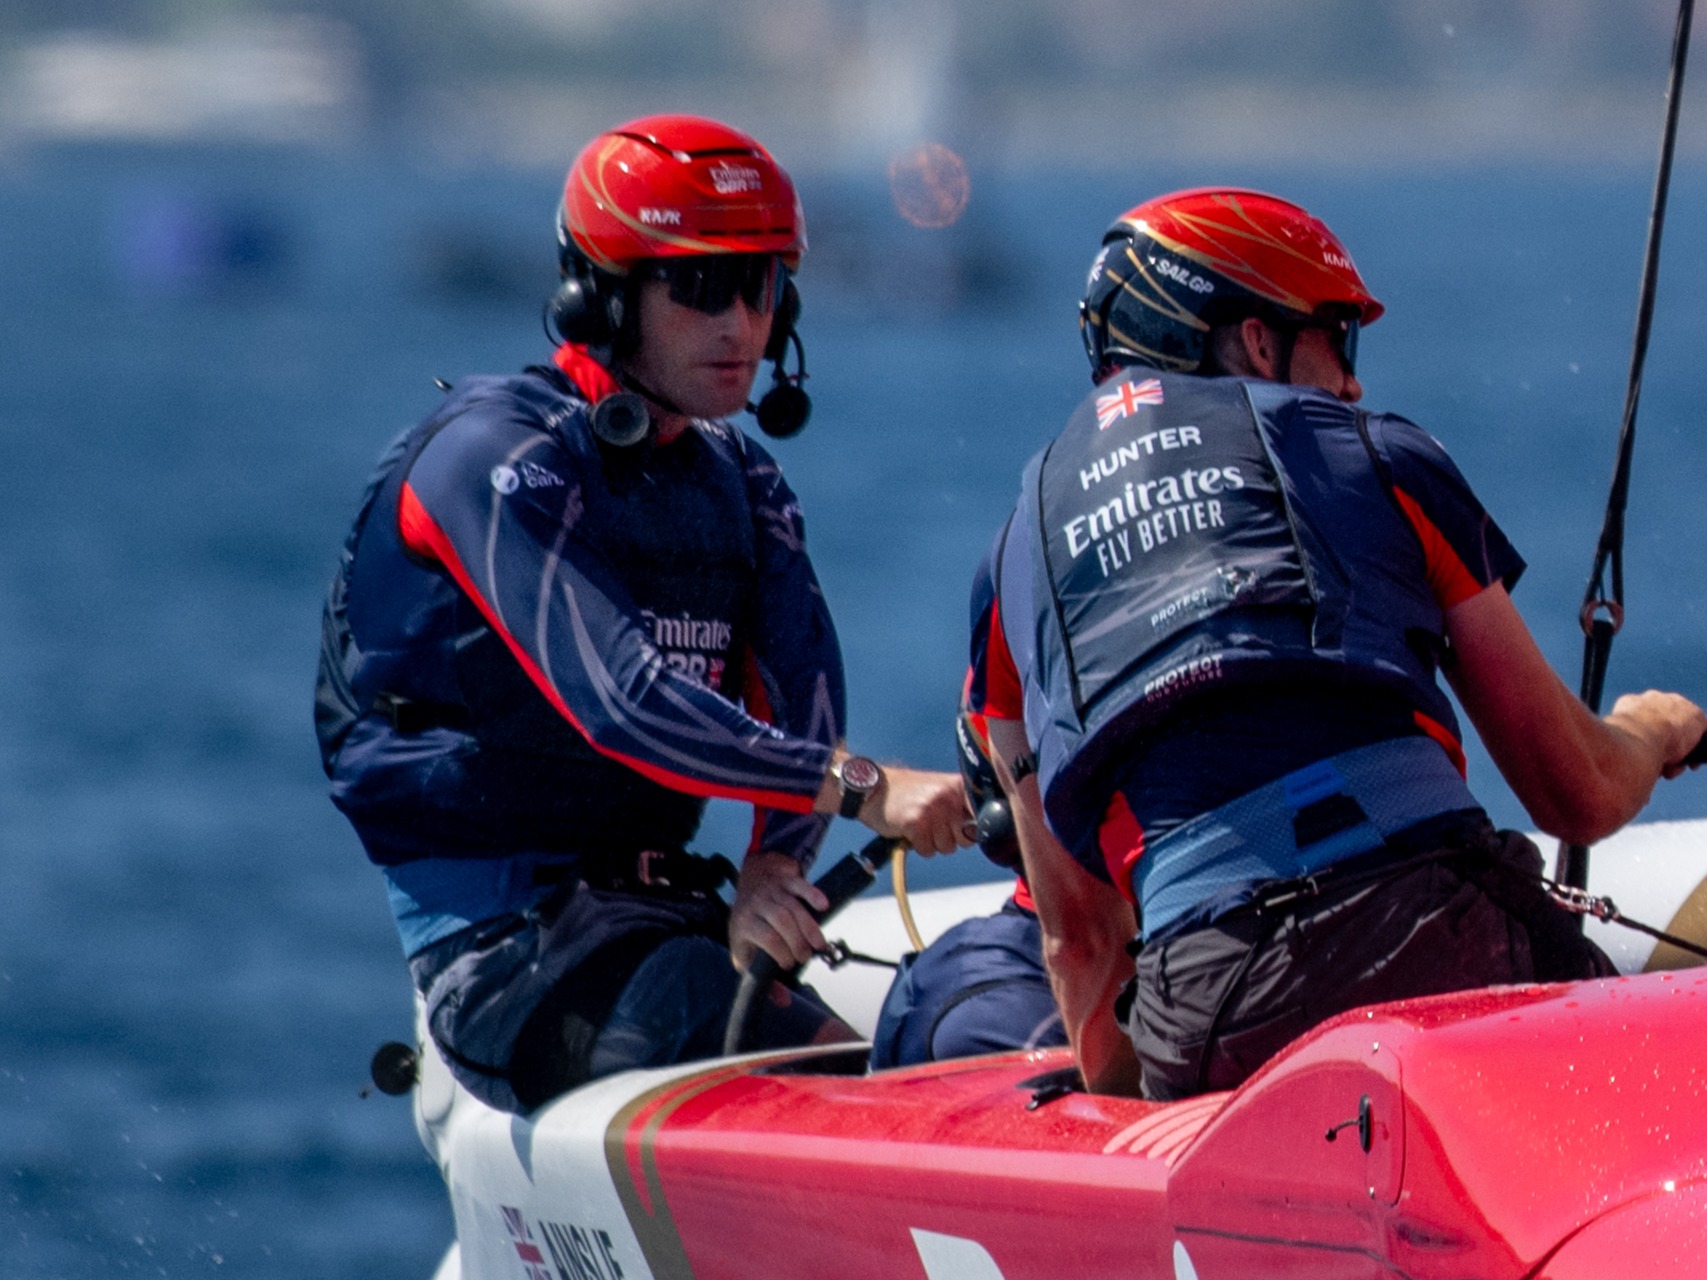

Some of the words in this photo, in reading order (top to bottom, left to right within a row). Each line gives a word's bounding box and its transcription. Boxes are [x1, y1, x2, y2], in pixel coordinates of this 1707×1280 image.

[1155, 258, 1215, 296] SAILGP
[1079, 425, 1203, 491] HUNTER
[1062, 465, 1245, 559] Emirates
[1096, 529, 1132, 578] FLY
[1137, 499, 1226, 554] BETTER
[1144, 653, 1223, 696] PROTECT
